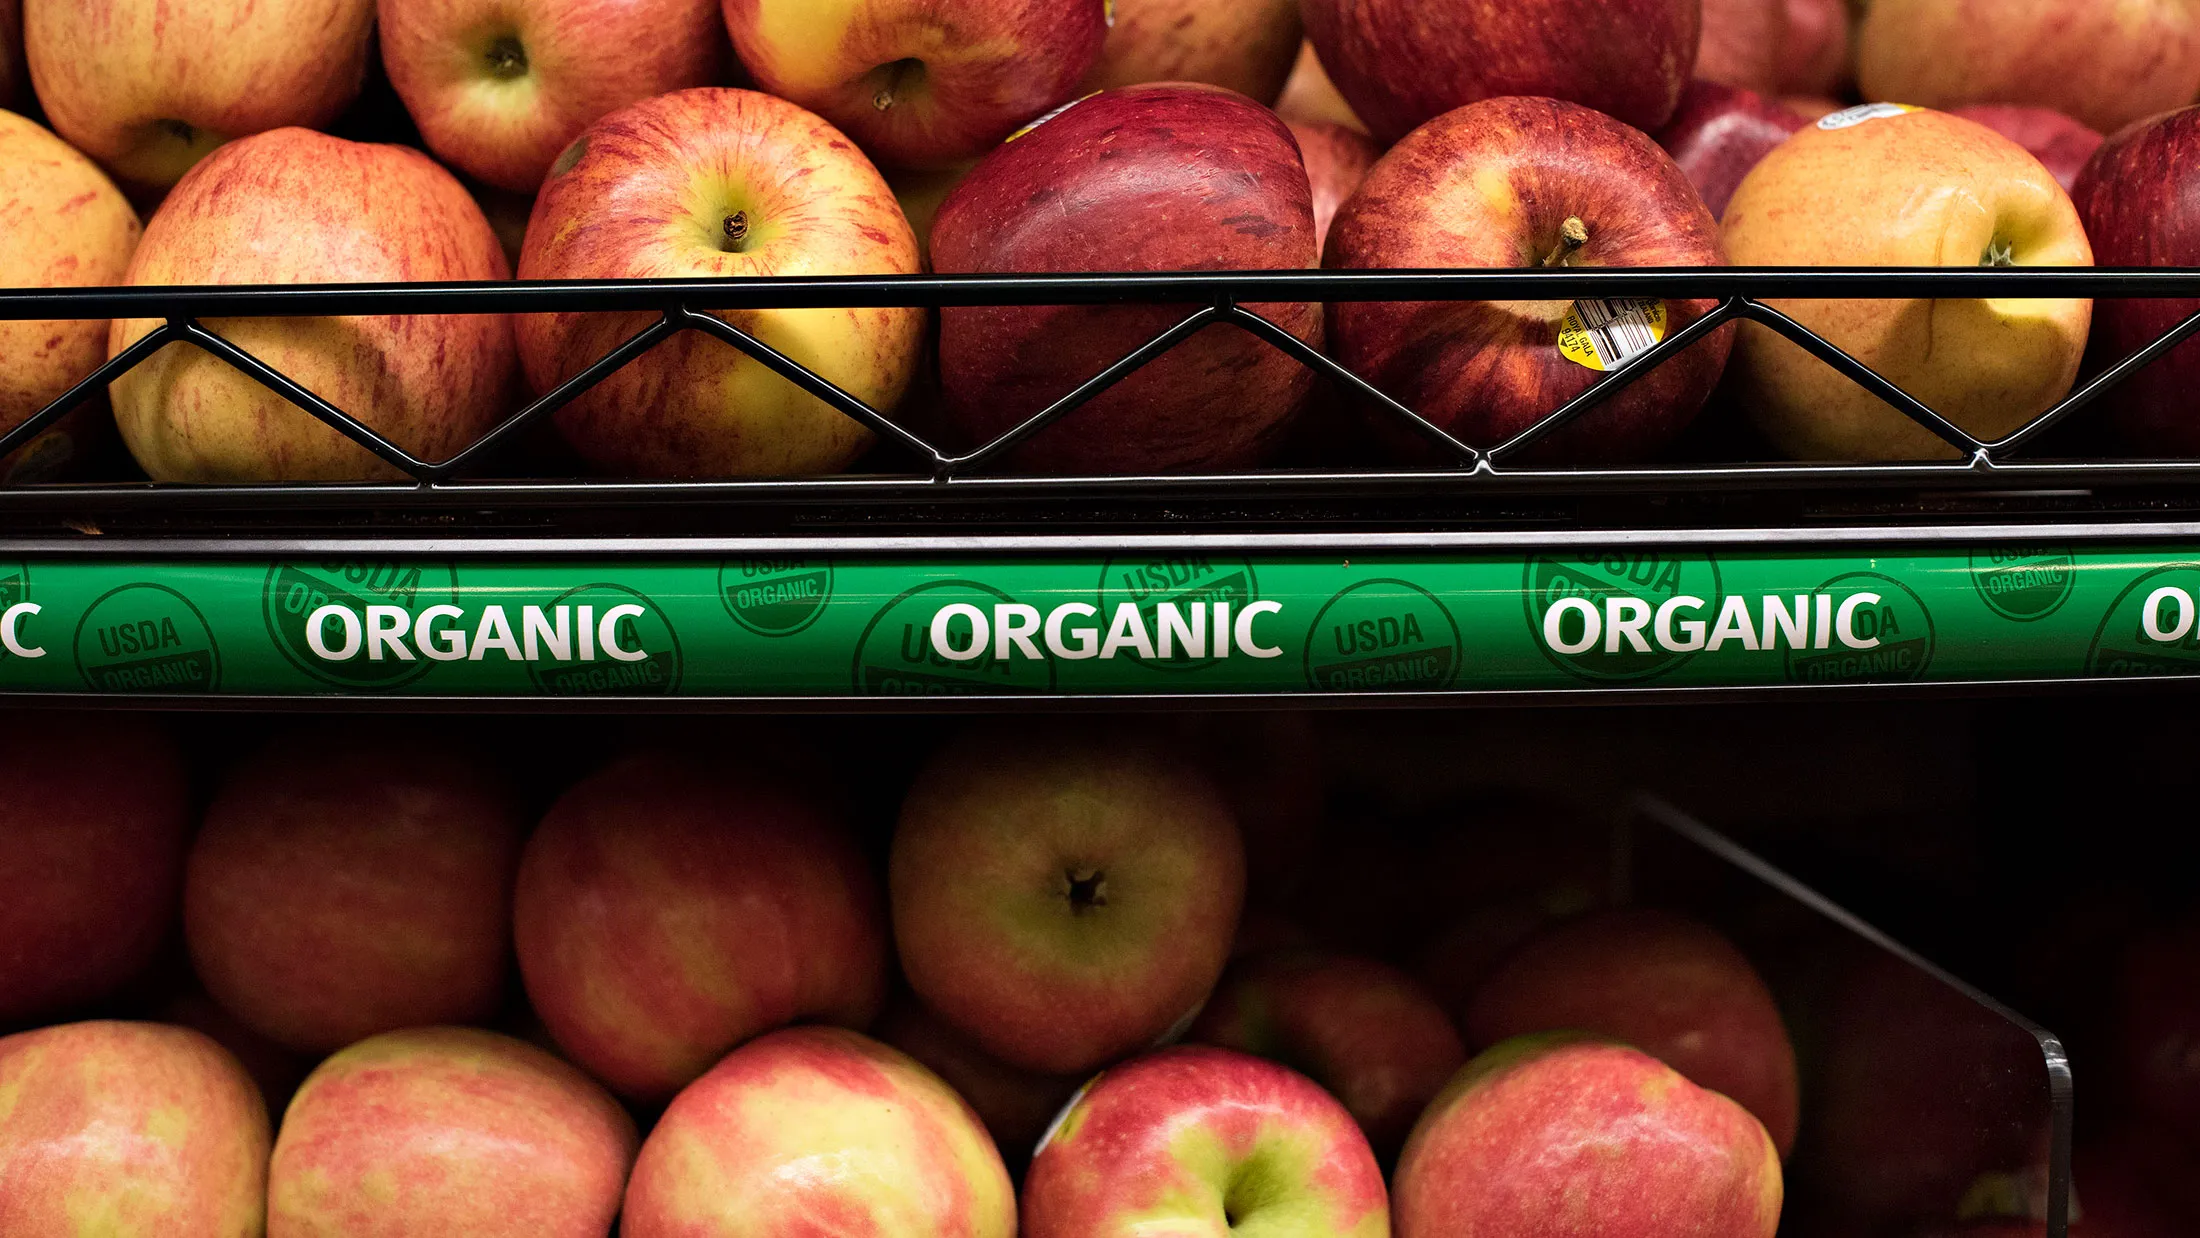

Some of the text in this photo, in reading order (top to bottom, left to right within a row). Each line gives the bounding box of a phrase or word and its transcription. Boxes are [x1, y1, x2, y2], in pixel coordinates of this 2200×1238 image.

[1561, 327, 1581, 353] 94174
[1567, 315, 1594, 357] ROYAL GALA
[737, 577, 819, 609] ORGANIC
[1989, 565, 2063, 595] ORGANIC
[97, 615, 182, 657] USDA
[305, 604, 649, 662] ORGANIC
[930, 600, 1284, 661] ORGANIC
[1334, 612, 1425, 656] USDA
[1543, 592, 1883, 655] ORGANIC
[103, 658, 203, 690] ORGANIC
[1329, 655, 1439, 690] ORGANIC
